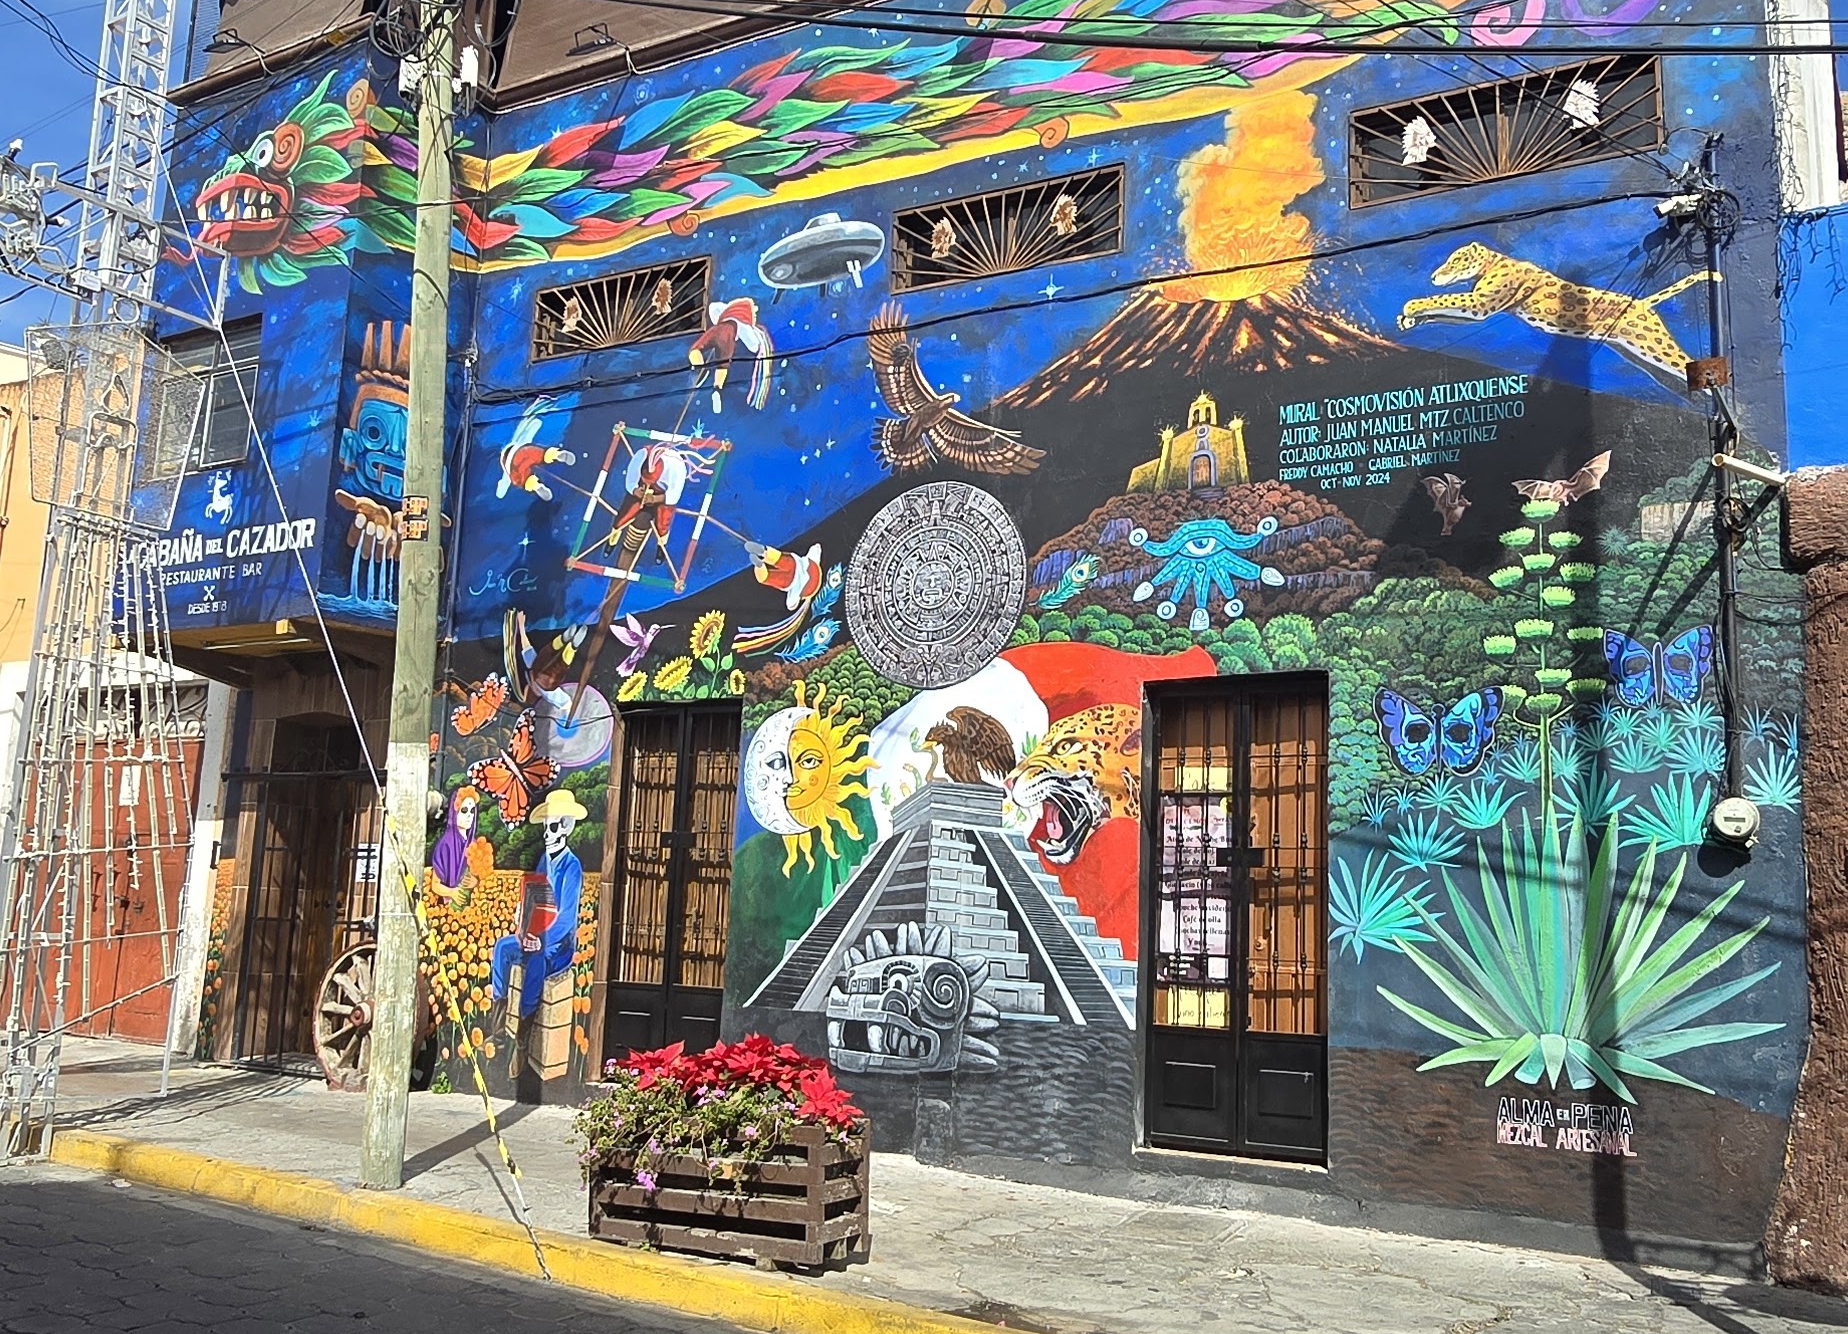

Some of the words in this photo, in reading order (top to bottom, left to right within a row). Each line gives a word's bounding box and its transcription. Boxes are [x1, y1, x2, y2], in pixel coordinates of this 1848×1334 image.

[1279, 402, 1321, 425] MURAL
[1428, 374, 1529, 406] ATLIXQUENSE
[1279, 425, 1321, 446] AUTOR:
[1323, 420, 1358, 443] JUAN
[1361, 413, 1415, 437] MANUEL
[1453, 400, 1525, 425] CALTENCO
[1279, 440, 1370, 464] COLABORARON:
[1373, 433, 1427, 454] NATALIA
[1432, 425, 1498, 448] MARTÍNEZ
[1279, 465, 1309, 481] FREDDY
[1310, 461, 1354, 478] CAMACHO
[1368, 455, 1407, 470] GABRIEL
[1365, 472, 1391, 486] 2024
[205, 537, 224, 556] DEL
[226, 517, 316, 559] CAZADOR
[161, 564, 236, 587] RESTAURANTE
[242, 562, 262, 577] BAR
[187, 602, 211, 615] DESDE
[1496, 1096, 1555, 1128] ALMA
[1571, 1103, 1634, 1135] PENA
[1496, 1122, 1548, 1148] MEZCAL
[1555, 1127, 1638, 1157] ARTESANAL
